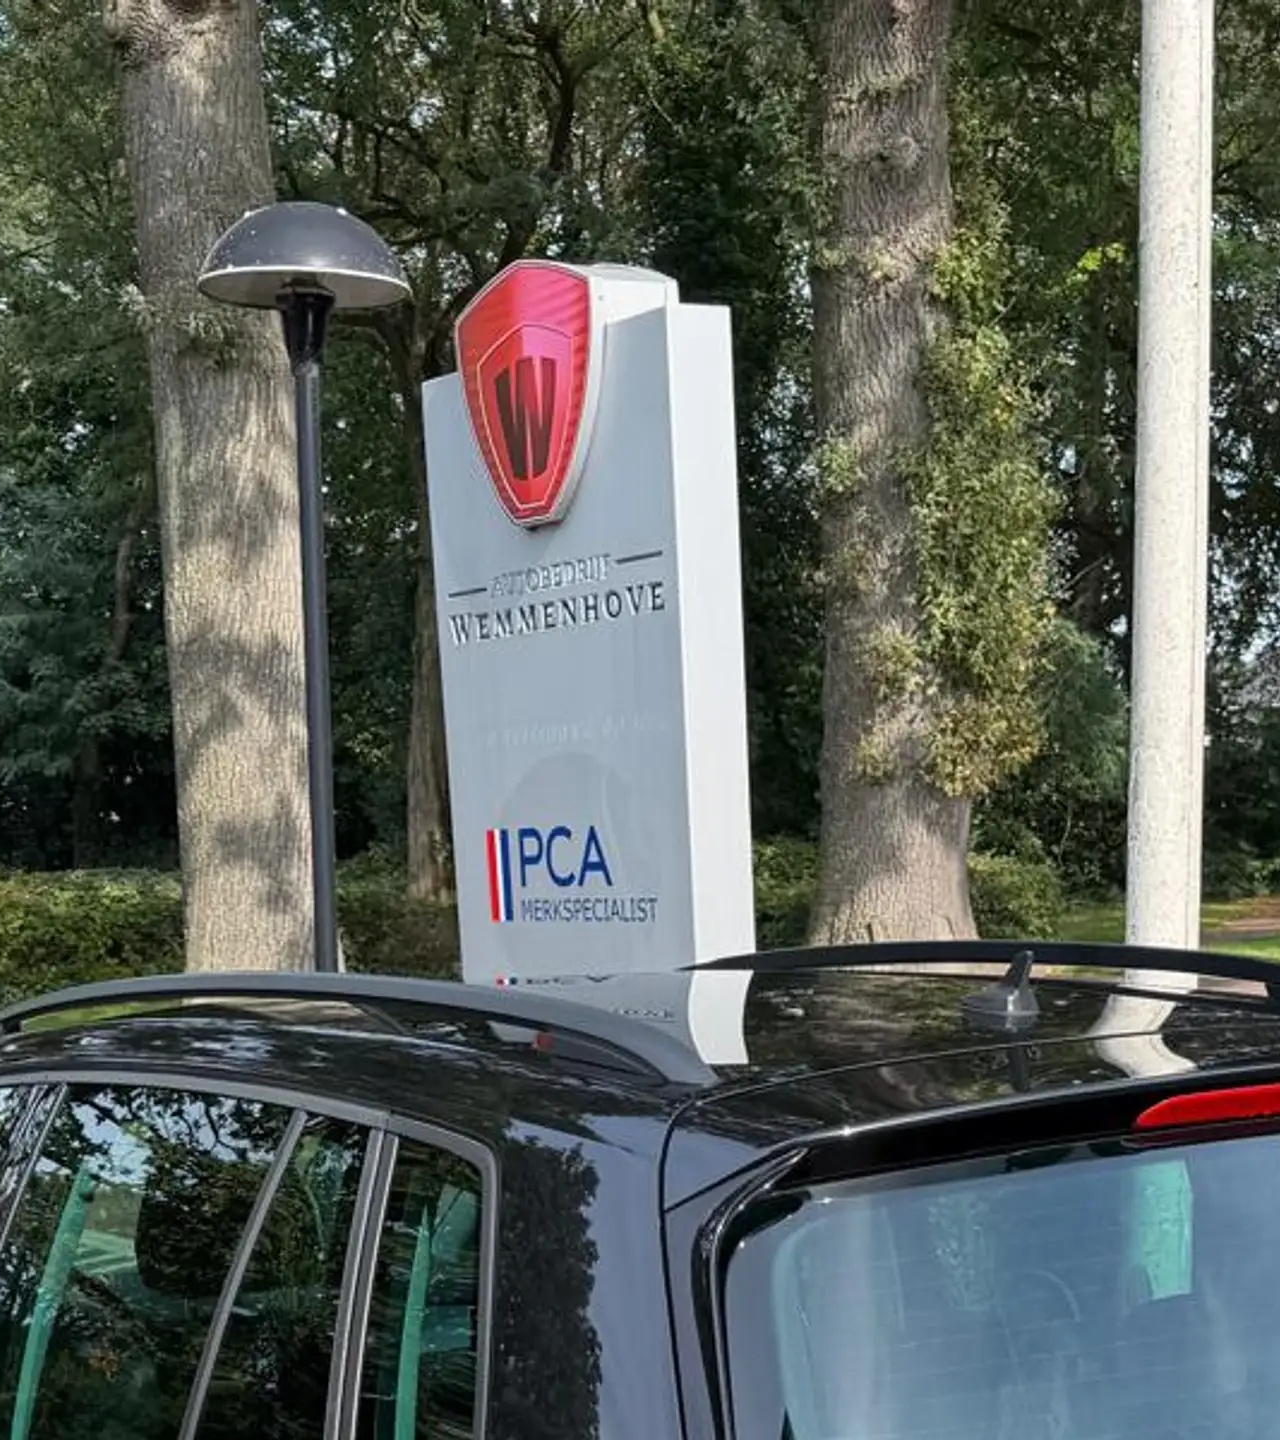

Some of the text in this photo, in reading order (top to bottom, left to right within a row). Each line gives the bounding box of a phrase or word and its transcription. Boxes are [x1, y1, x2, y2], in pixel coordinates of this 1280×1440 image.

[494, 355, 557, 480] W
[449, 582, 665, 645] WEMMENHOVE
[518, 826, 613, 887] PCA
[520, 896, 657, 922] MERKSPECIALIST
